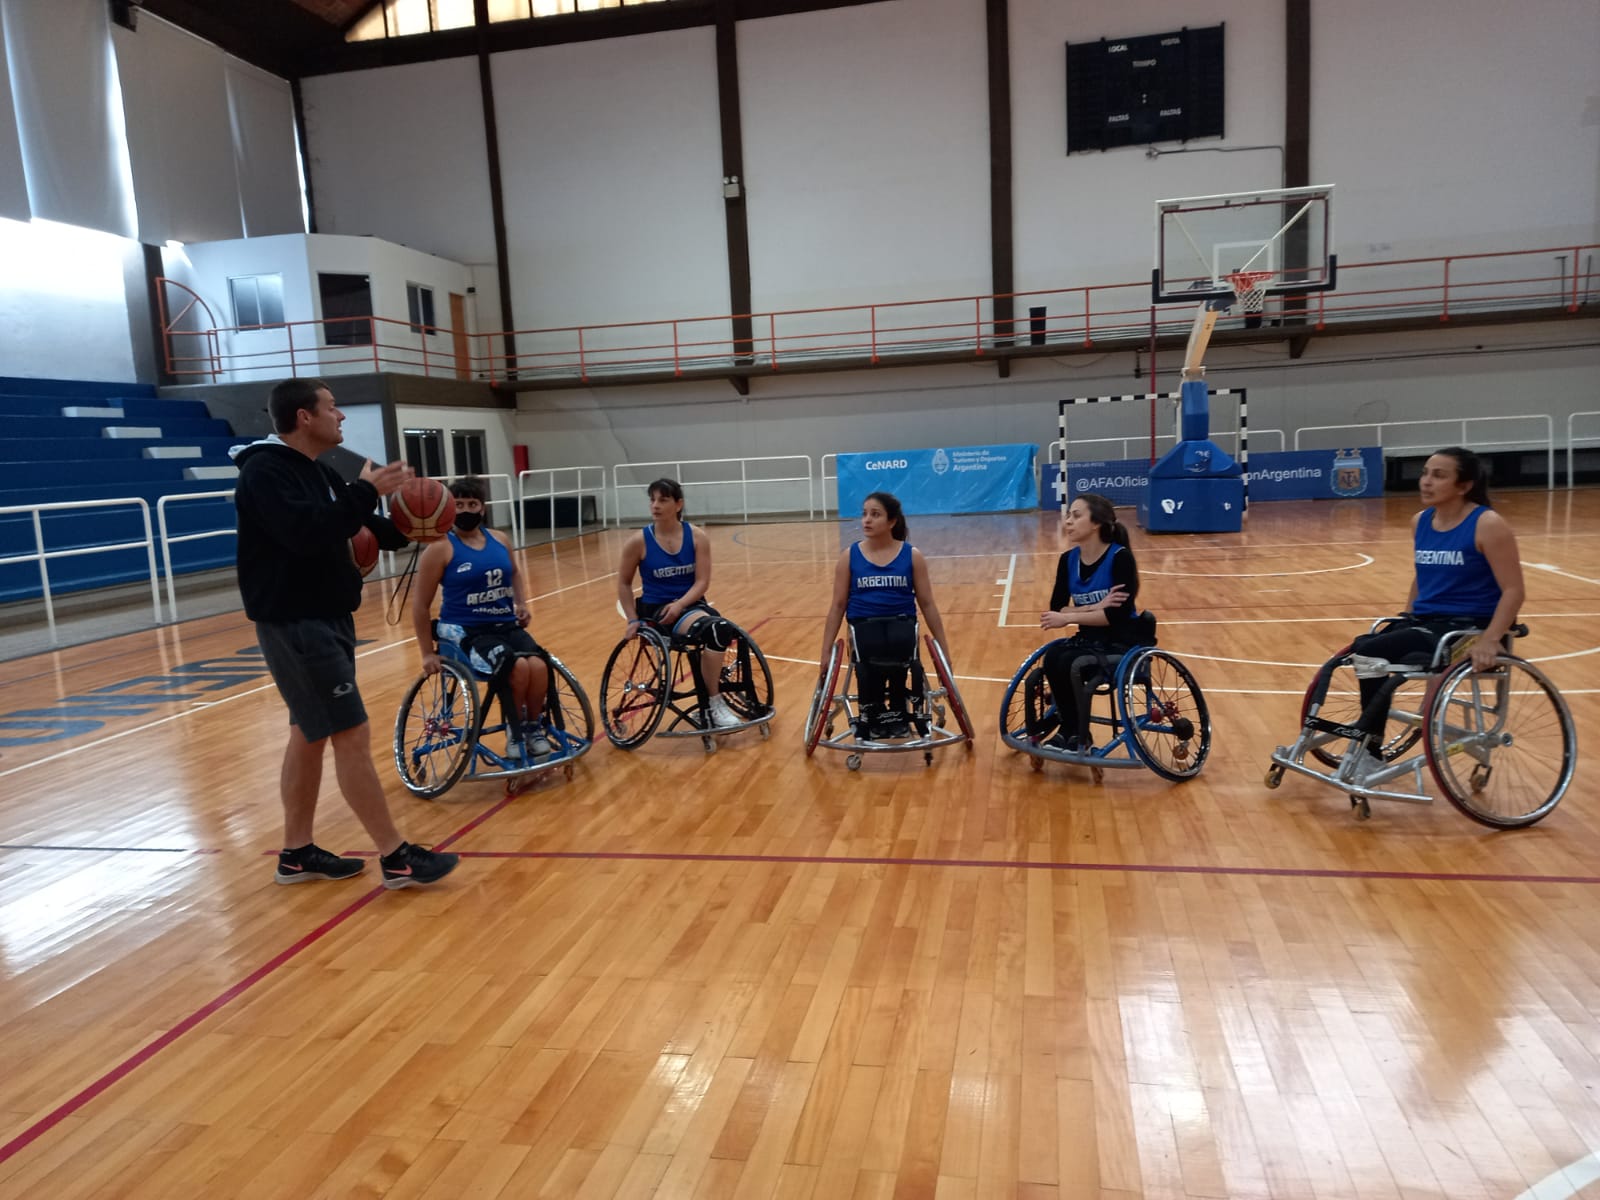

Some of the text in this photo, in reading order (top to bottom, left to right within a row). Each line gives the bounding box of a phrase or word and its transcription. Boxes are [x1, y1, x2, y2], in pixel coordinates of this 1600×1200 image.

[1108, 44, 1128, 53] LOCAL
[1108, 114, 1130, 123] FALTAS
[1160, 108, 1181, 117] FALTAS
[865, 459, 908, 471] CeNARD
[953, 464, 987, 472] Argentina
[1245, 467, 1322, 482] onArgentina
[1076, 476, 1149, 492] @AFAOficia
[485, 568, 503, 588] 12
[857, 575, 908, 588] ARGENTINA
